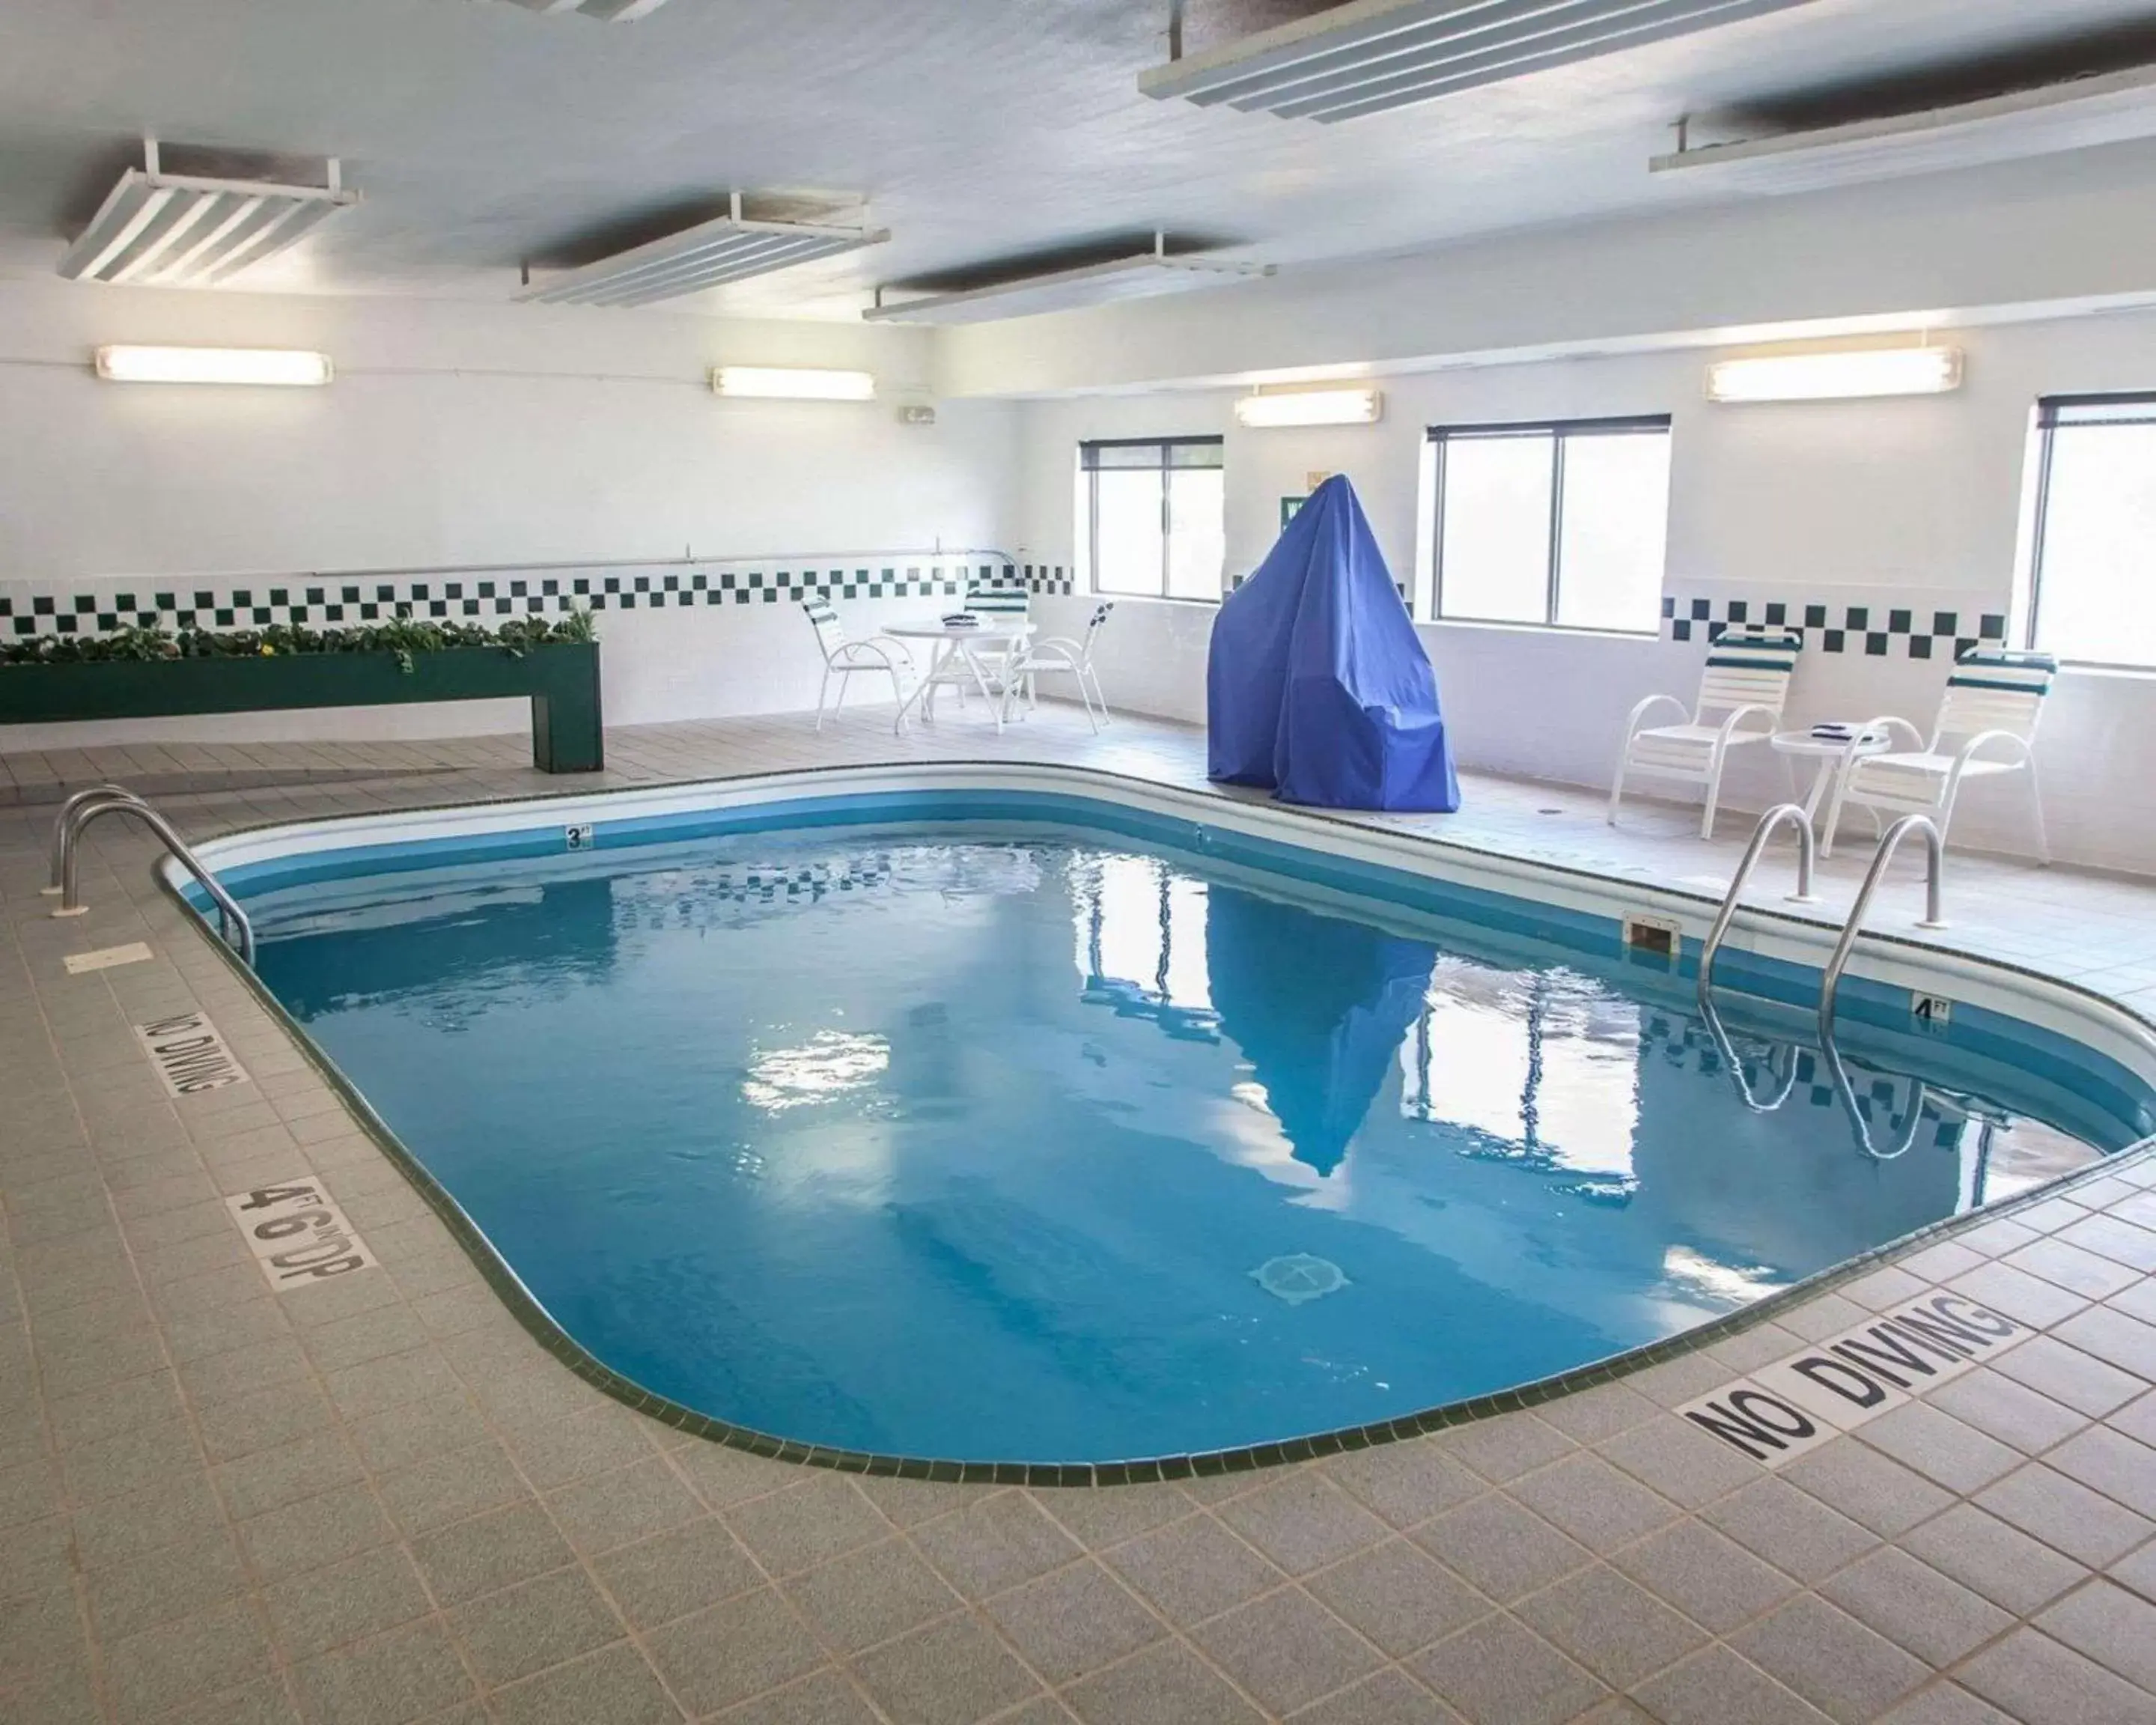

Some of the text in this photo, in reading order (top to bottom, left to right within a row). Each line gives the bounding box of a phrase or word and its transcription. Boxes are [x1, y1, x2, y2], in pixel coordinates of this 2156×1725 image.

[143, 1012, 240, 1093] NO DIVING
[1684, 1296, 2014, 1461] NO DIVING
